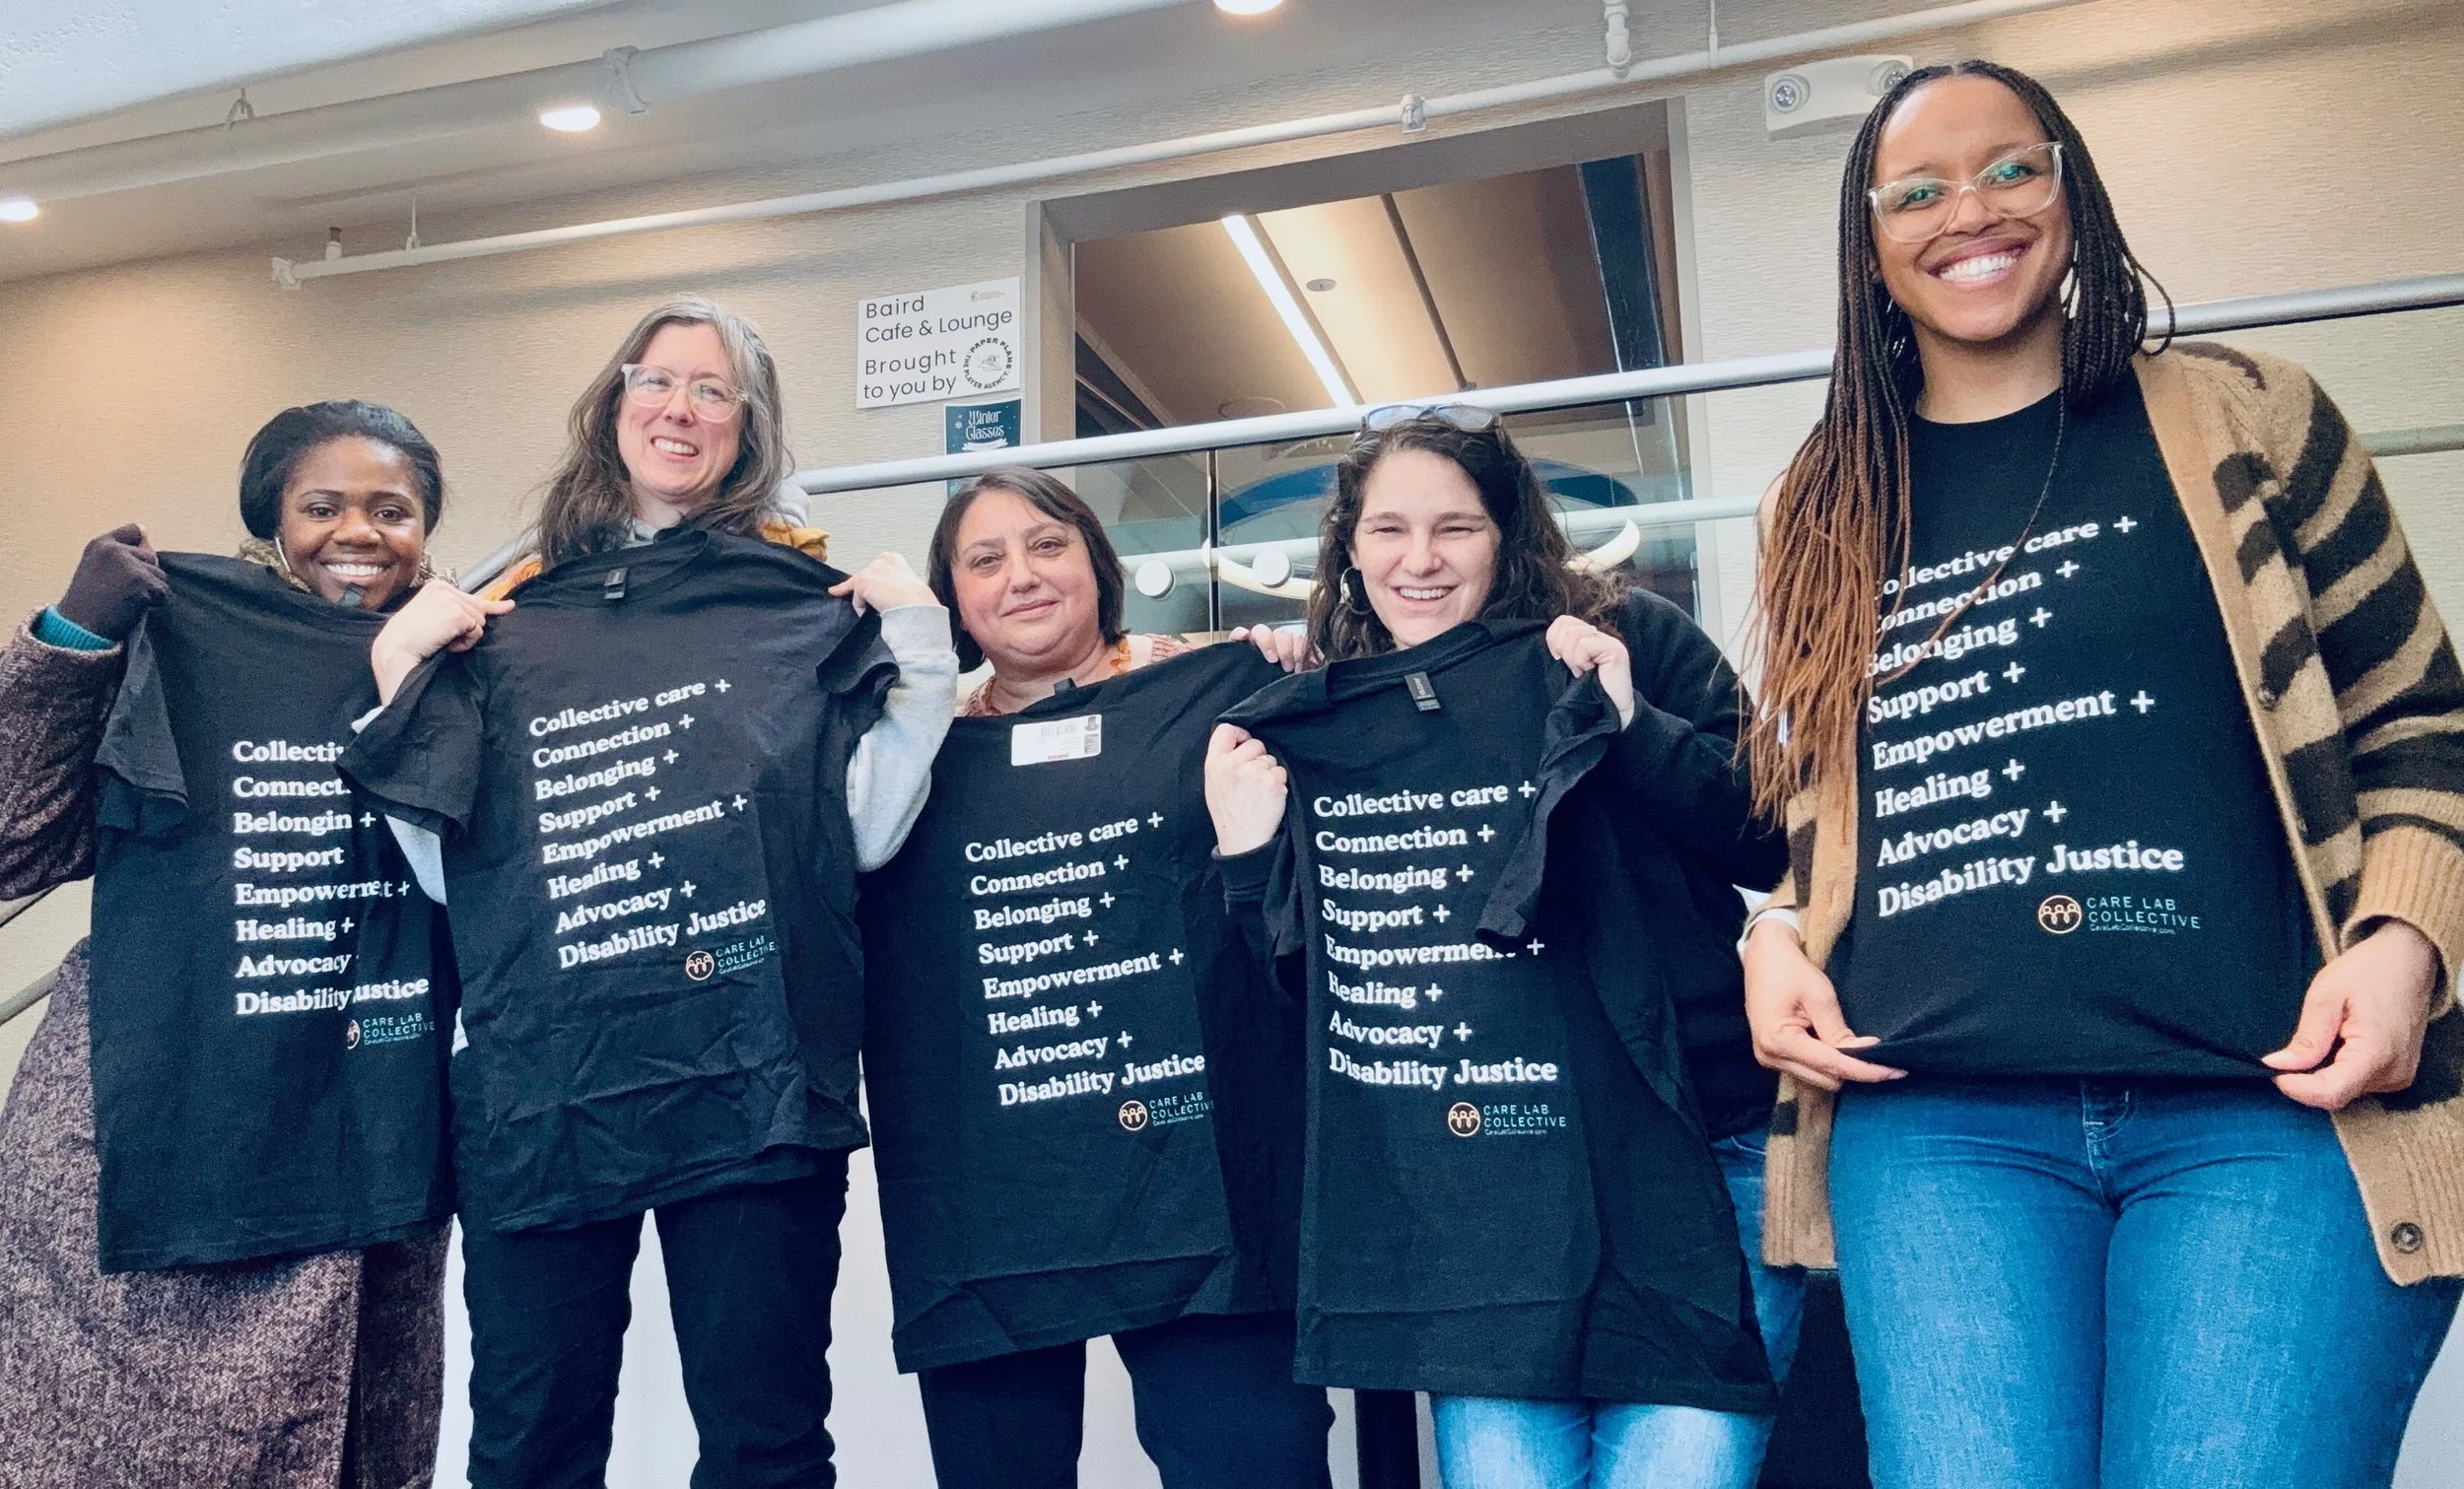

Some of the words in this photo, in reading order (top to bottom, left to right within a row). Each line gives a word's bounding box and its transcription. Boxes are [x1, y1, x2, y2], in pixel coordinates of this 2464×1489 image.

[866, 296, 924, 318] Baird
[865, 323, 913, 343] Cafe
[919, 320, 932, 335] &
[940, 310, 1012, 333] Lounge
[865, 349, 956, 374] Brought
[970, 337, 997, 353] PAPER
[999, 341, 1013, 369] PLANE
[863, 384, 883, 399] to
[890, 380, 925, 401] you
[932, 376, 956, 394] by
[984, 371, 1009, 389] AGENCY
[969, 410, 1001, 426] Winter
[1875, 546, 2016, 600] olective
[2023, 522, 2099, 554] care
[2113, 515, 2138, 533] +
[1875, 572, 2042, 633] onnecion
[2055, 560, 2080, 578] +
[2028, 606, 2053, 629] +
[528, 697, 650, 737] Collective
[654, 682, 706, 708] care
[714, 678, 732, 694] +
[1868, 670, 1992, 723] Support
[2002, 661, 2025, 684] +
[532, 721, 671, 769] Connection
[678, 713, 695, 729] +
[1872, 690, 2117, 771] Empowerment
[2130, 690, 2156, 713] +
[232, 739, 345, 763] Collecti
[232, 776, 352, 798] Connect
[534, 756, 656, 801] Belonging
[662, 749, 680, 765] +
[1875, 769, 1992, 818] Healing
[2002, 758, 2025, 781] +
[538, 791, 638, 834] Support
[644, 785, 661, 802] +
[1313, 789, 1444, 818] Collective
[1450, 784, 1509, 807] care
[1517, 779, 1537, 798] +
[233, 809, 353, 837] Belongin
[359, 811, 376, 828] +
[542, 800, 724, 864] Empowerment
[731, 793, 748, 812] +
[965, 831, 1083, 862] Collective
[1088, 818, 1138, 843] care
[1147, 811, 1164, 829] +
[1315, 825, 1469, 853] Connection
[1476, 824, 1495, 843] +
[1877, 808, 2030, 867] Advocacy
[2042, 800, 2068, 824] +
[233, 846, 345, 873] Support
[547, 858, 642, 900] Healing
[648, 851, 665, 869] +
[970, 860, 1106, 896] Connection
[1113, 853, 1129, 871] +
[397, 880, 410, 897] +
[1318, 864, 1448, 895] Belonging
[1455, 863, 1474, 883] +
[1878, 855, 2036, 917] Disability
[2045, 840, 2184, 874] Justice
[554, 887, 672, 935] Advocacy
[679, 880, 697, 898] +
[973, 897, 1092, 930] Belonging
[1099, 891, 1116, 909] +
[1322, 898, 1424, 933] Support
[1432, 904, 1451, 923] +
[2087, 897, 2132, 909] CARE
[2143, 898, 2176, 911] LAB
[2088, 911, 2201, 929] COLLECTIVE
[235, 916, 337, 942] Healing
[341, 916, 355, 933] +
[558, 922, 680, 969] Disability
[686, 899, 767, 936] Justice
[978, 932, 1075, 965] Support
[1082, 929, 1099, 947] +
[716, 942, 745, 957] CARE
[1325, 933, 1516, 971] Empowerme
[1526, 938, 1545, 956] +
[982, 952, 1162, 999] Empowerment
[1168, 948, 1185, 966] +
[1328, 970, 1417, 1010] Healing
[1424, 982, 1443, 1002] +
[235, 986, 353, 1015] Disability
[352, 978, 430, 1004] ustice
[363, 1017, 394, 1029] CARE
[400, 1013, 422, 1025] LAB
[364, 1021, 434, 1039] COLLECTIVE
[987, 1005, 1080, 1035] Healing
[1086, 999, 1103, 1018] +
[1329, 1010, 1444, 1049] Advocacy
[1453, 1021, 1472, 1042] +
[993, 1037, 1109, 1070] Advocacy
[1117, 1030, 1133, 1049] +
[997, 1070, 1116, 1106] Disability
[1121, 1053, 1205, 1086] Justice
[1329, 1047, 1448, 1091] Disability
[1453, 1056, 1558, 1085] Justice
[1149, 1096, 1178, 1110] CARE
[1184, 1092, 1202, 1103] LAB
[1483, 1106, 1517, 1116] CARE
[1524, 1105, 1548, 1115] LAB
[1484, 1117, 1566, 1127] COLLECTIVE
